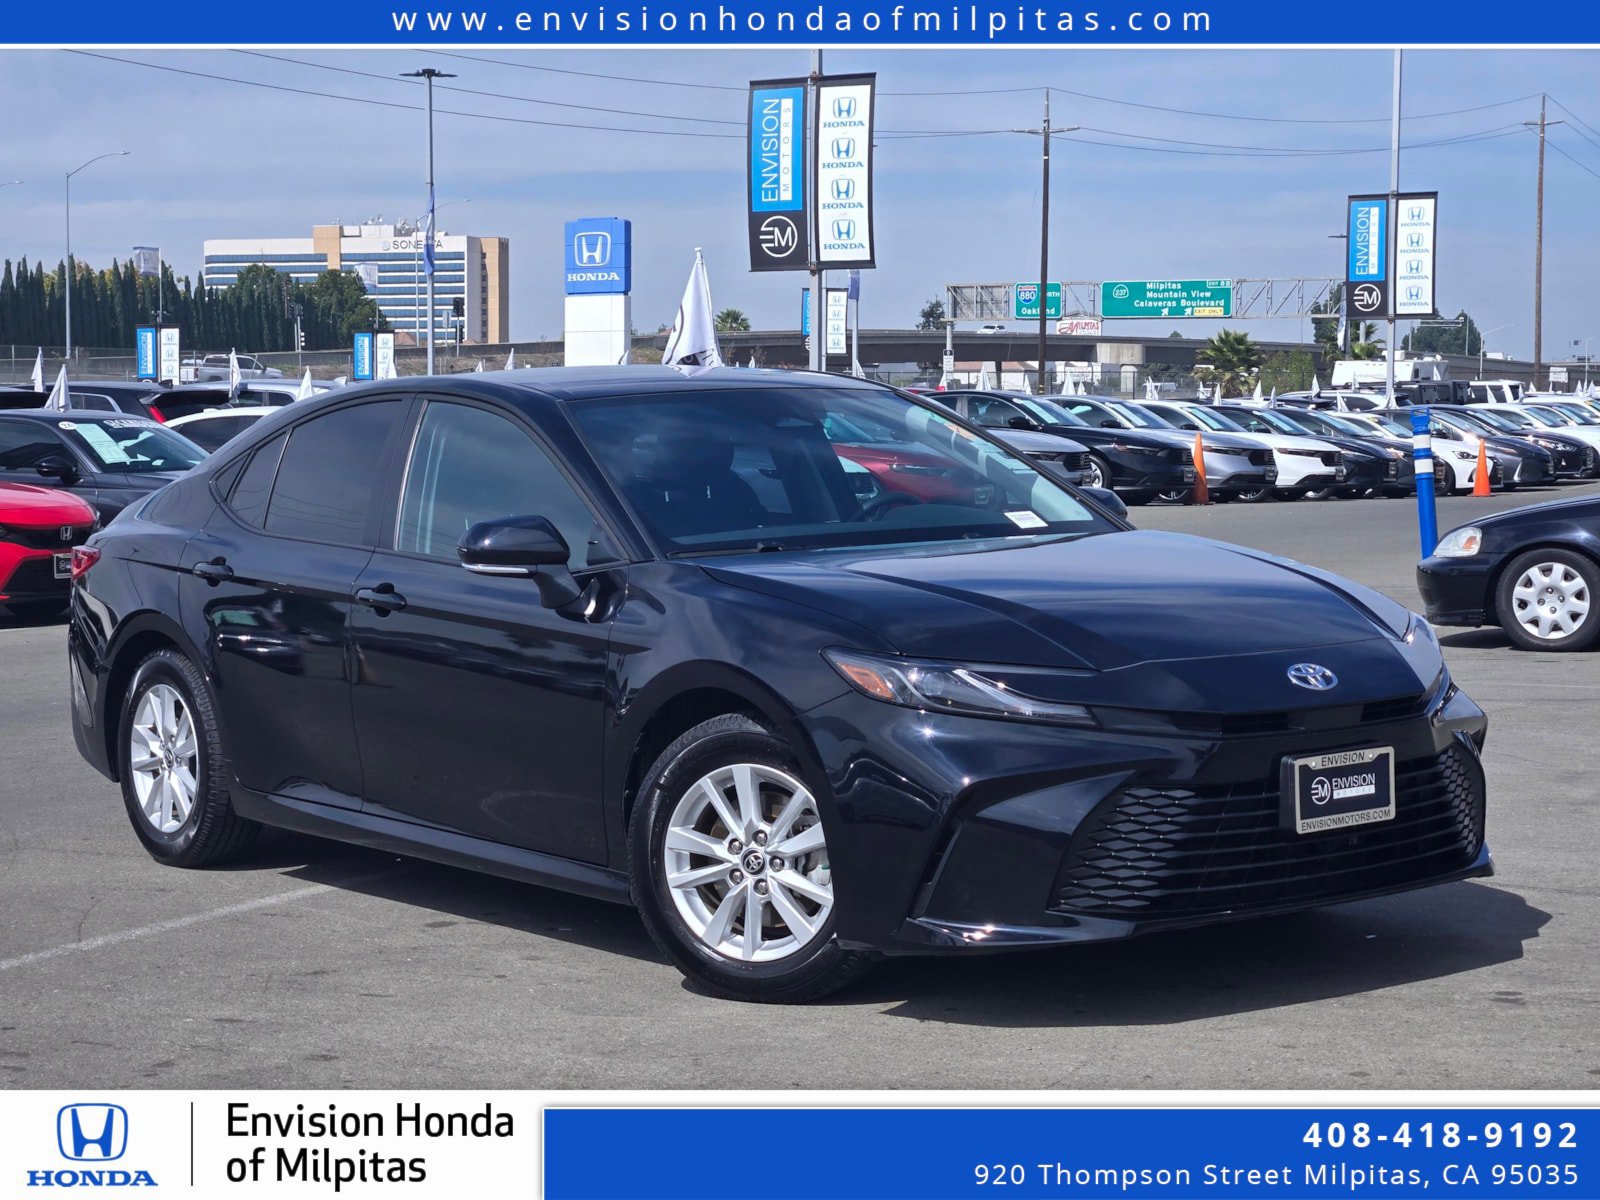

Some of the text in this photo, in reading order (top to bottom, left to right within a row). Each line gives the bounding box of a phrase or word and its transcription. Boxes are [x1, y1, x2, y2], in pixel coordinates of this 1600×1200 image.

[822, 120, 865, 129] HONDA
[761, 98, 780, 202] ENVISION
[782, 107, 791, 192] MOTORS
[822, 161, 865, 169] HONDA
[822, 201, 865, 210] HONDA
[392, 240, 443, 250] SONEA
[1355, 207, 1370, 275] ENVISION
[823, 242, 866, 250] HONDA
[567, 272, 620, 282] HONDA
[1146, 282, 1182, 291] Milpitas
[1020, 291, 1035, 300] 880
[1146, 290, 1212, 298] Mountain View
[1134, 299, 1225, 307] Calaveras Boulevard
[1321, 751, 1365, 767] ENVISION
[1332, 773, 1376, 790] ENVISION
[1301, 809, 1391, 832] ENVISIONMOTORS.COM
